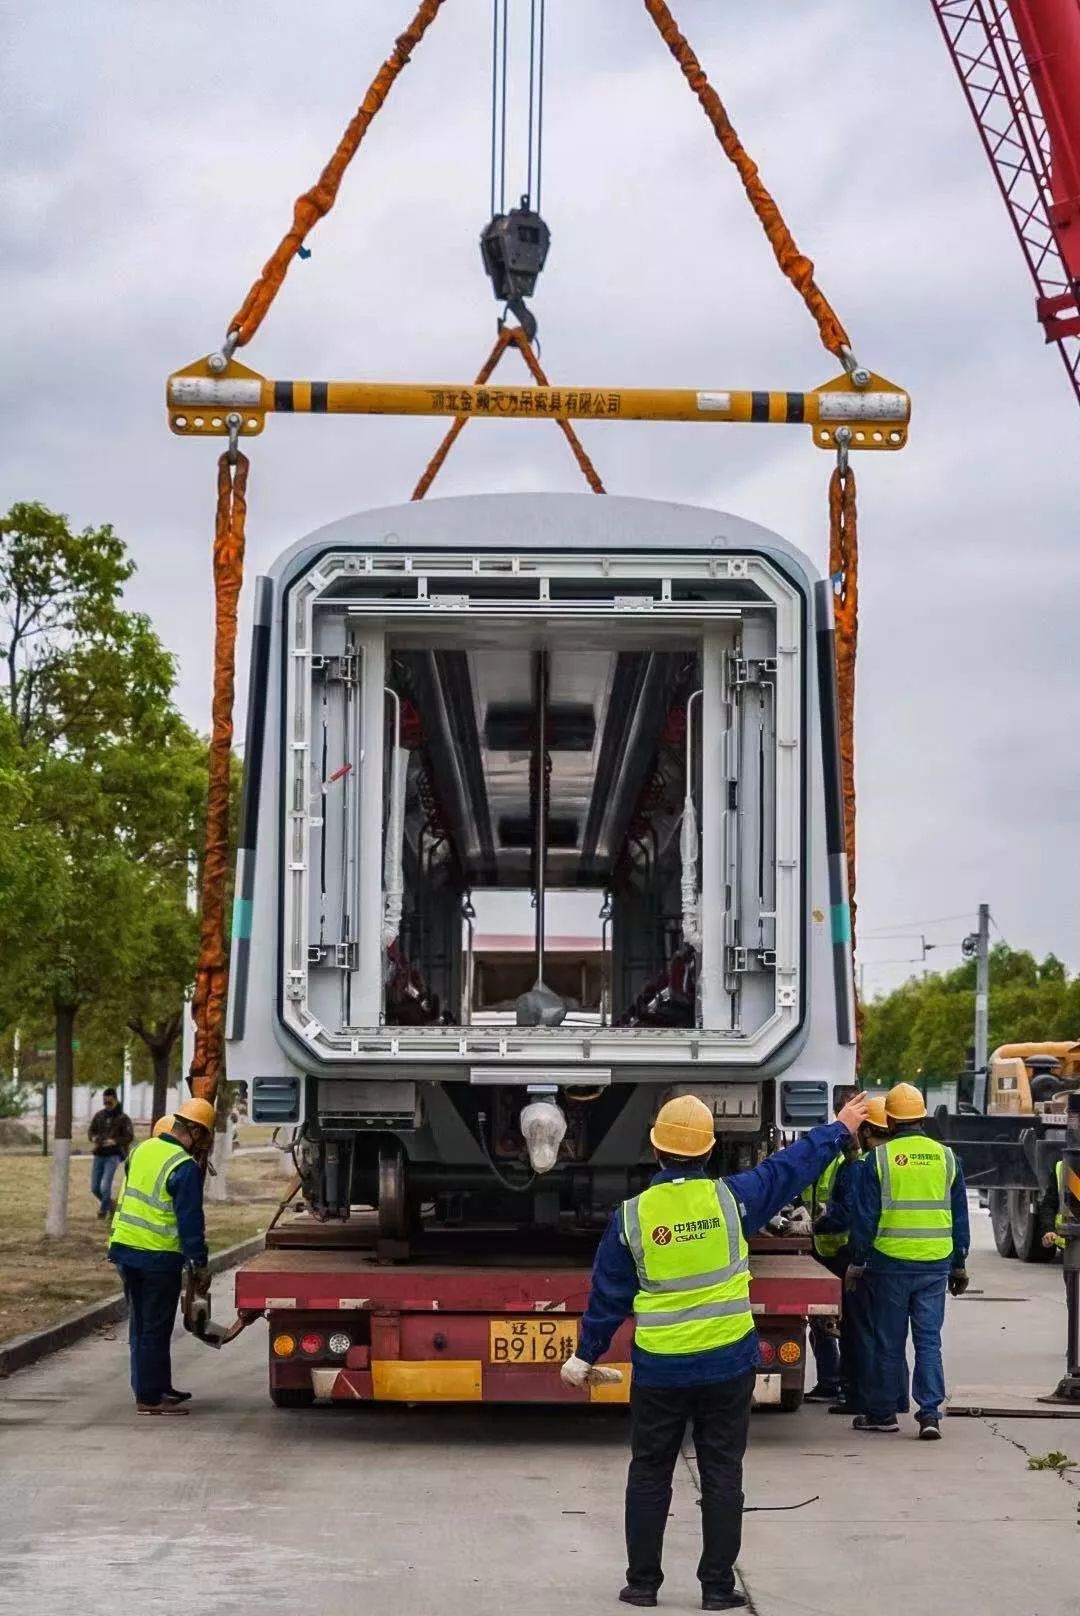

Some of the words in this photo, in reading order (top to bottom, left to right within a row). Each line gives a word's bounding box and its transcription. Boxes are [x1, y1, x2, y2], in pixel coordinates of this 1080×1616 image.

[673, 1217, 721, 1234] 中特物流
[675, 1232, 706, 1243] CSALC
